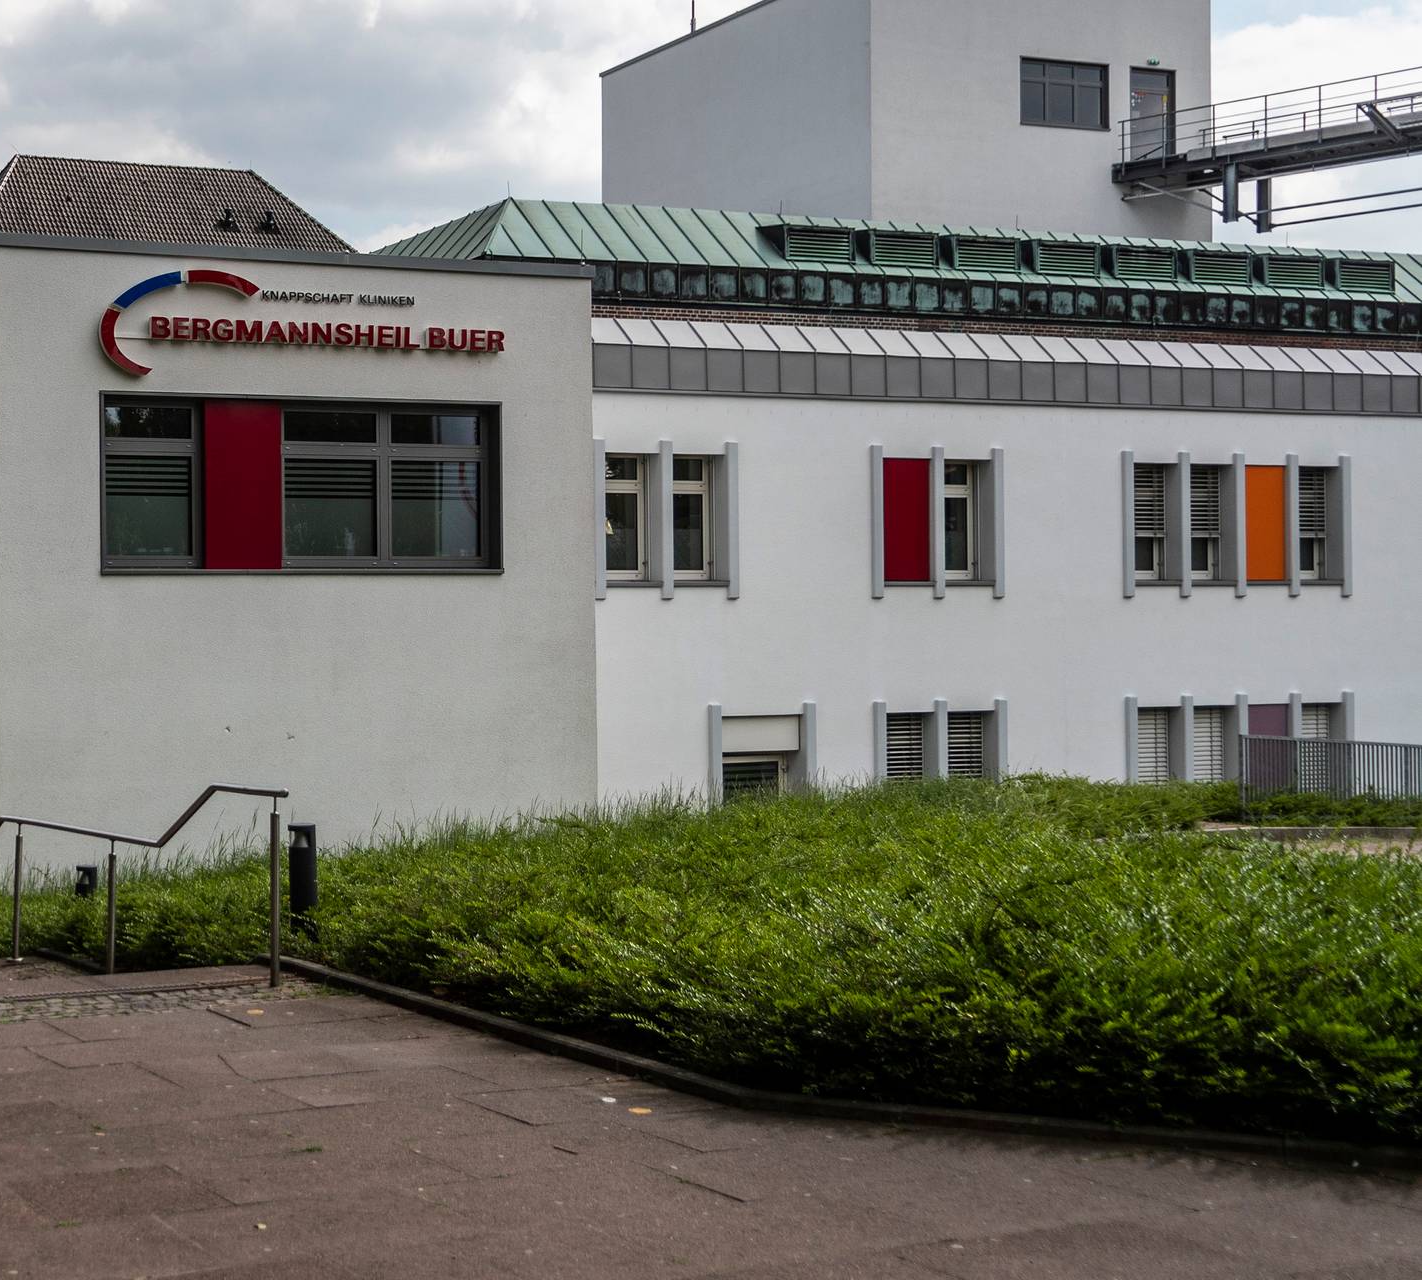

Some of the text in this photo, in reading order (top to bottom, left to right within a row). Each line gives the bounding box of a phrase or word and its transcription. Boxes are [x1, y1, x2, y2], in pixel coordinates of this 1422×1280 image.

[261, 290, 415, 306] KNAPPSCHAFT KLINIKEN
[149, 316, 506, 352] BERGMANNSHEIL BUER
